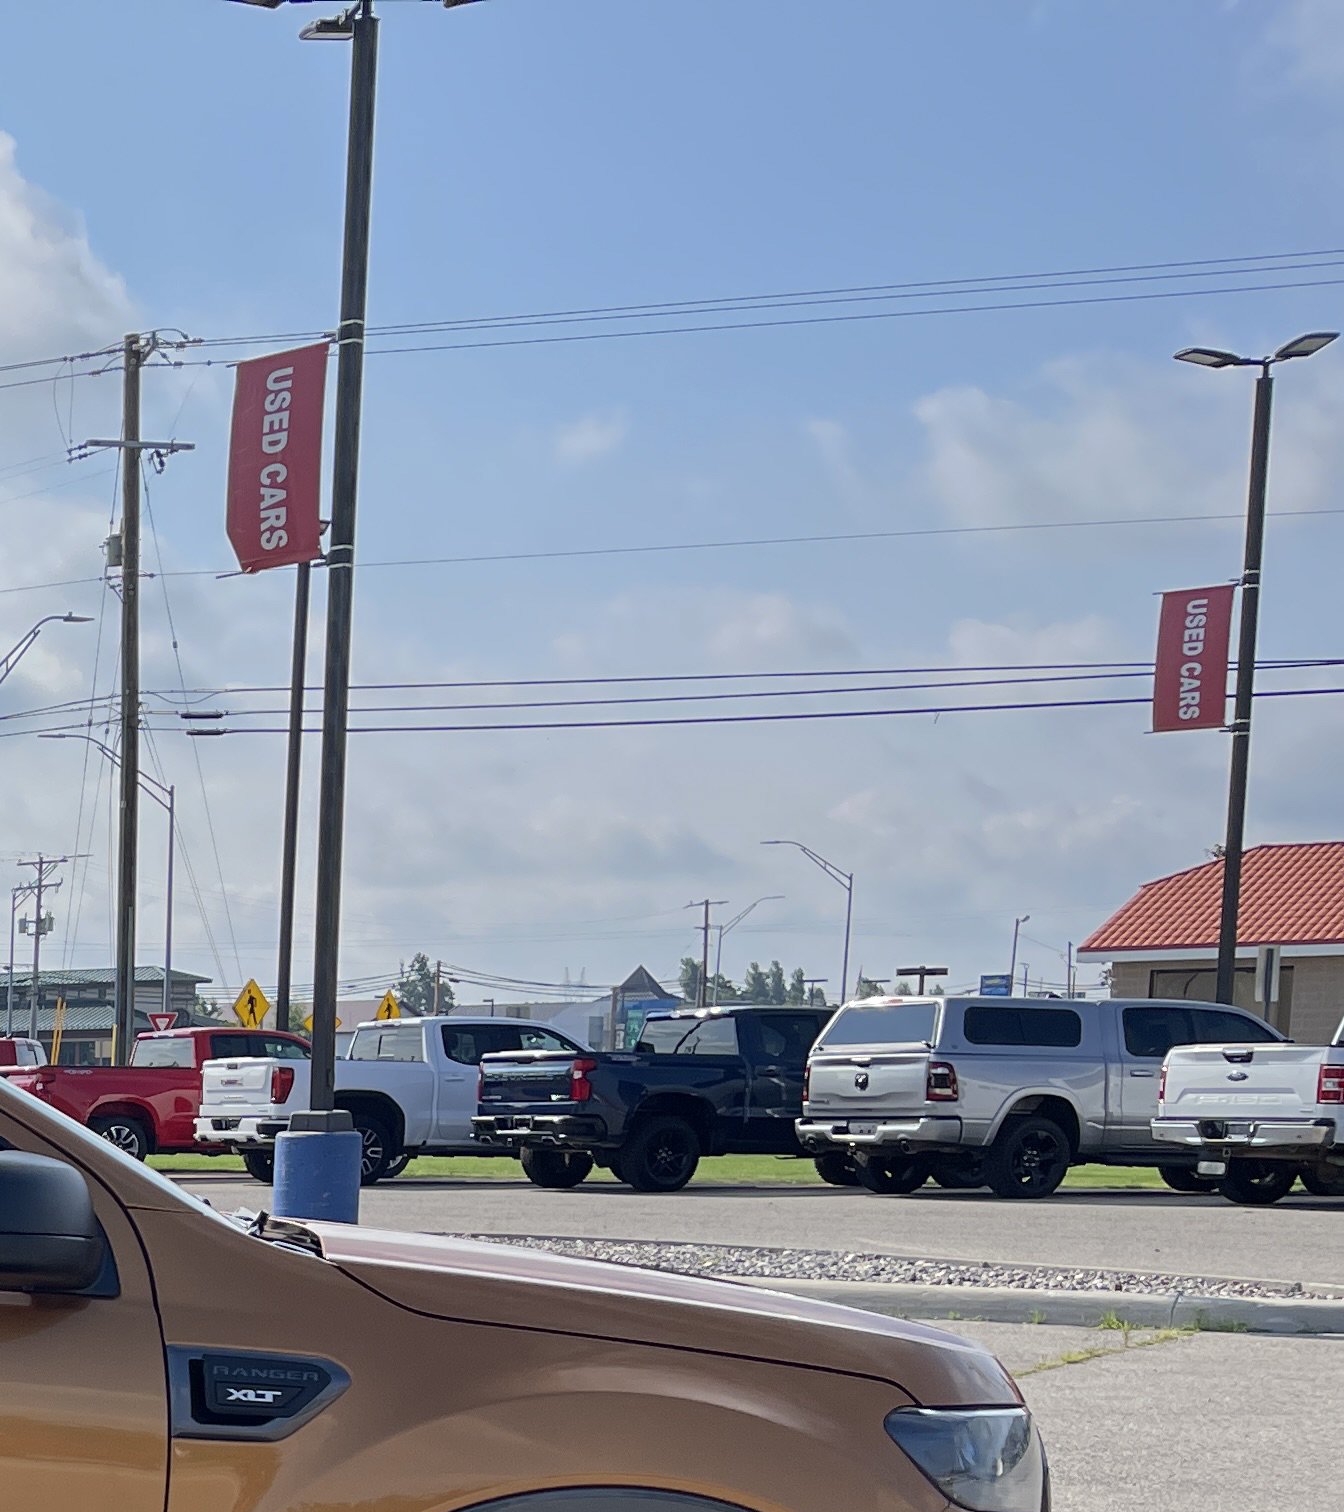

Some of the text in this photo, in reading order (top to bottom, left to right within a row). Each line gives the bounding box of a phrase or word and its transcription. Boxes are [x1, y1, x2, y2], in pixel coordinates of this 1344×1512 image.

[260, 367, 294, 550] USED CARS
[1179, 599, 1208, 720] USED CARS
[213, 1366, 319, 1382] RANGER
[226, 1387, 283, 1403] XLT
